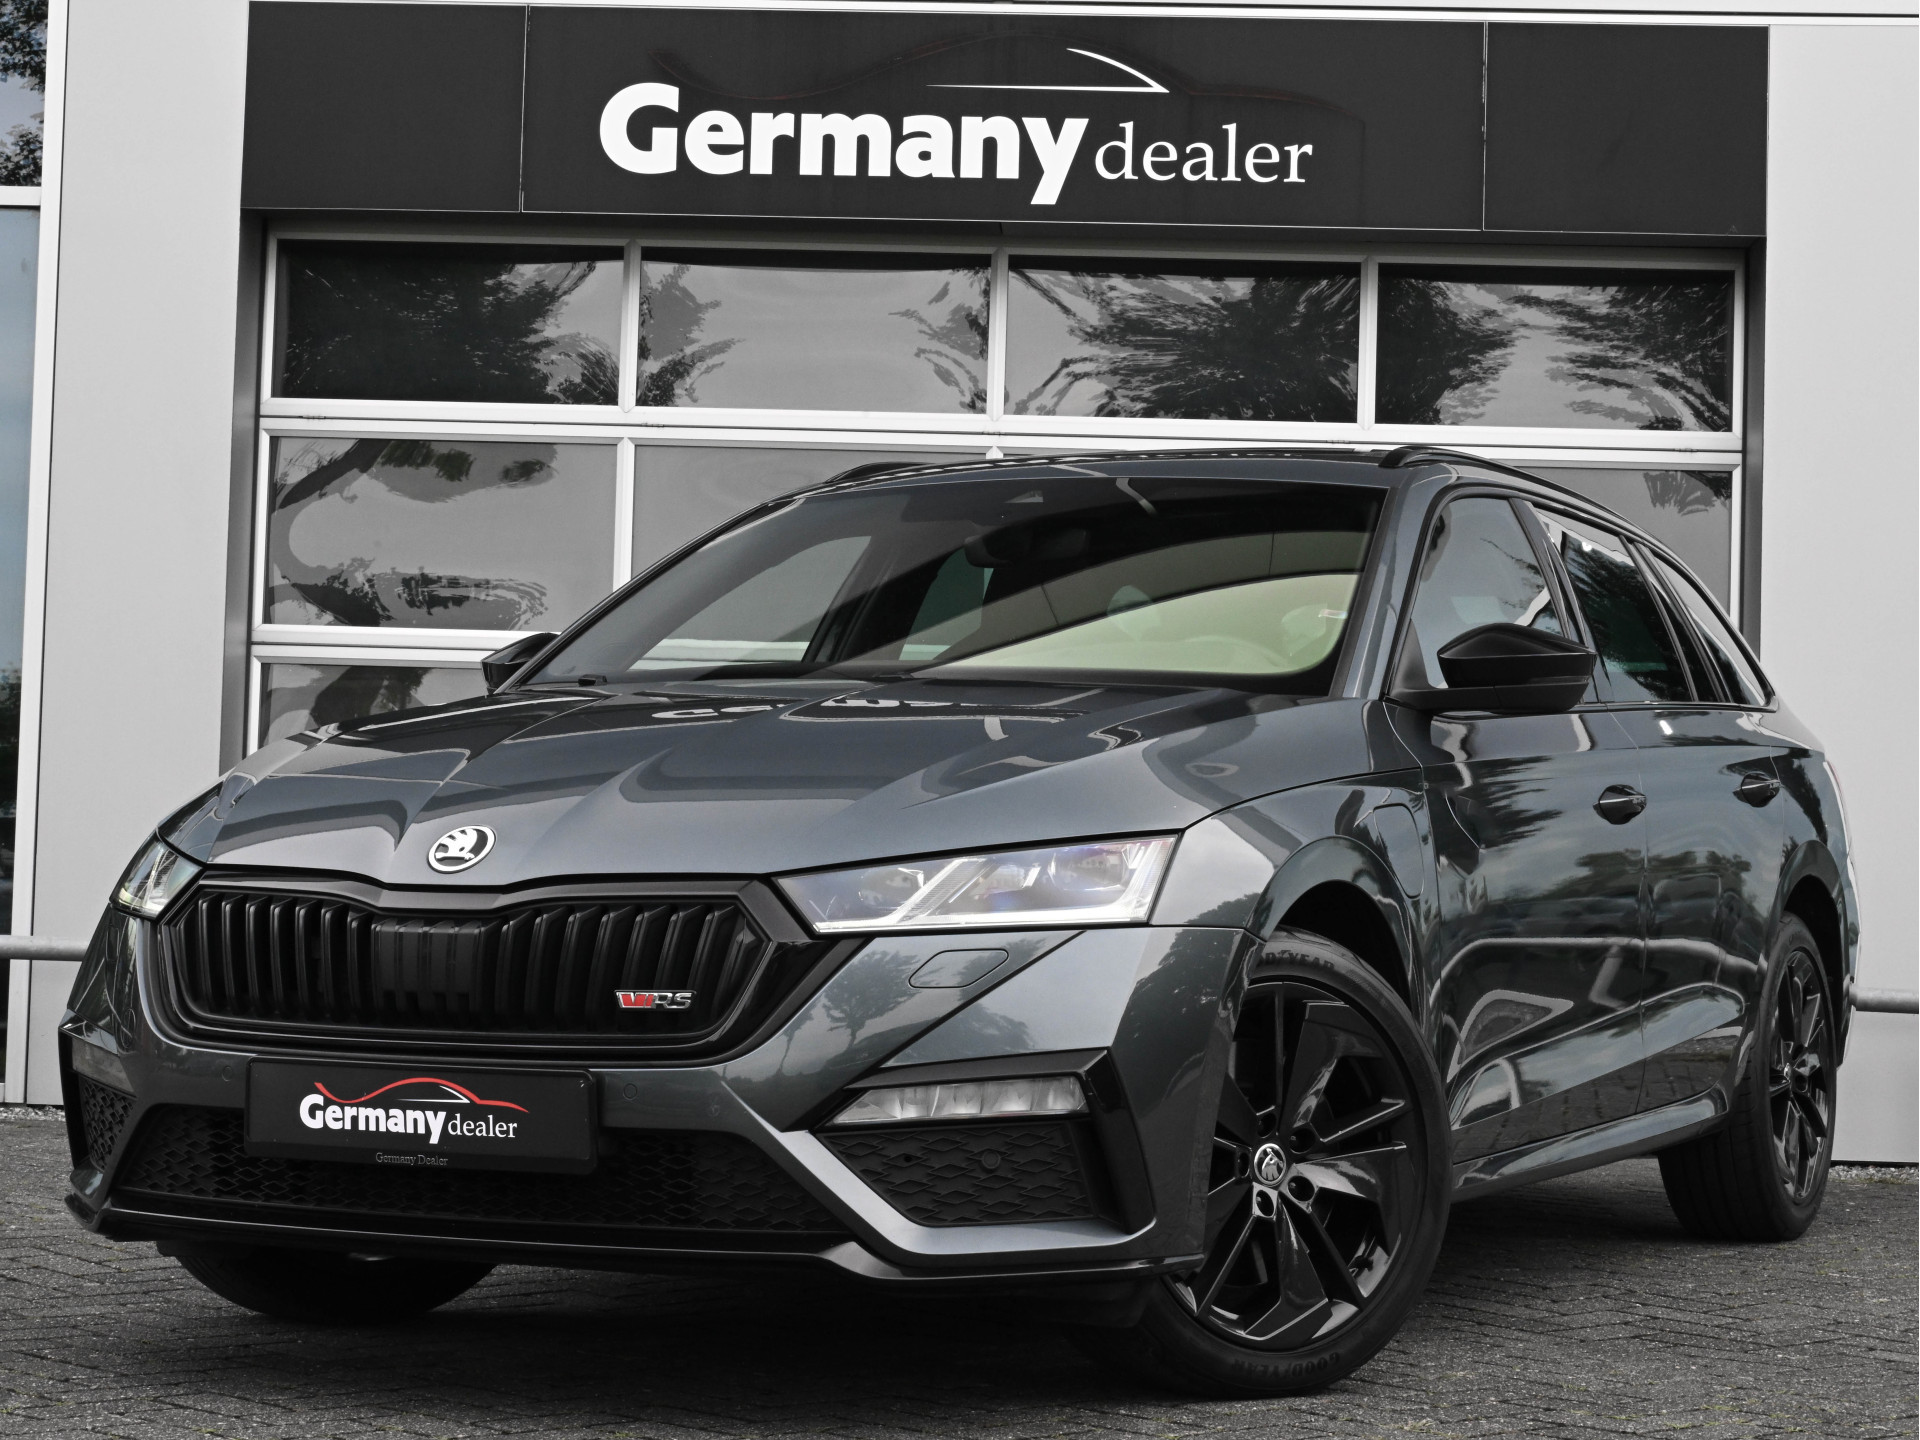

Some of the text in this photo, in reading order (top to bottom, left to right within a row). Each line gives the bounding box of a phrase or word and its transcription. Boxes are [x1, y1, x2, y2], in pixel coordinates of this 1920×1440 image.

[600, 82, 1313, 205] Germany dealer
[300, 1093, 518, 1144] Germany dealer
[375, 1152, 449, 1166] Germany Dealer
